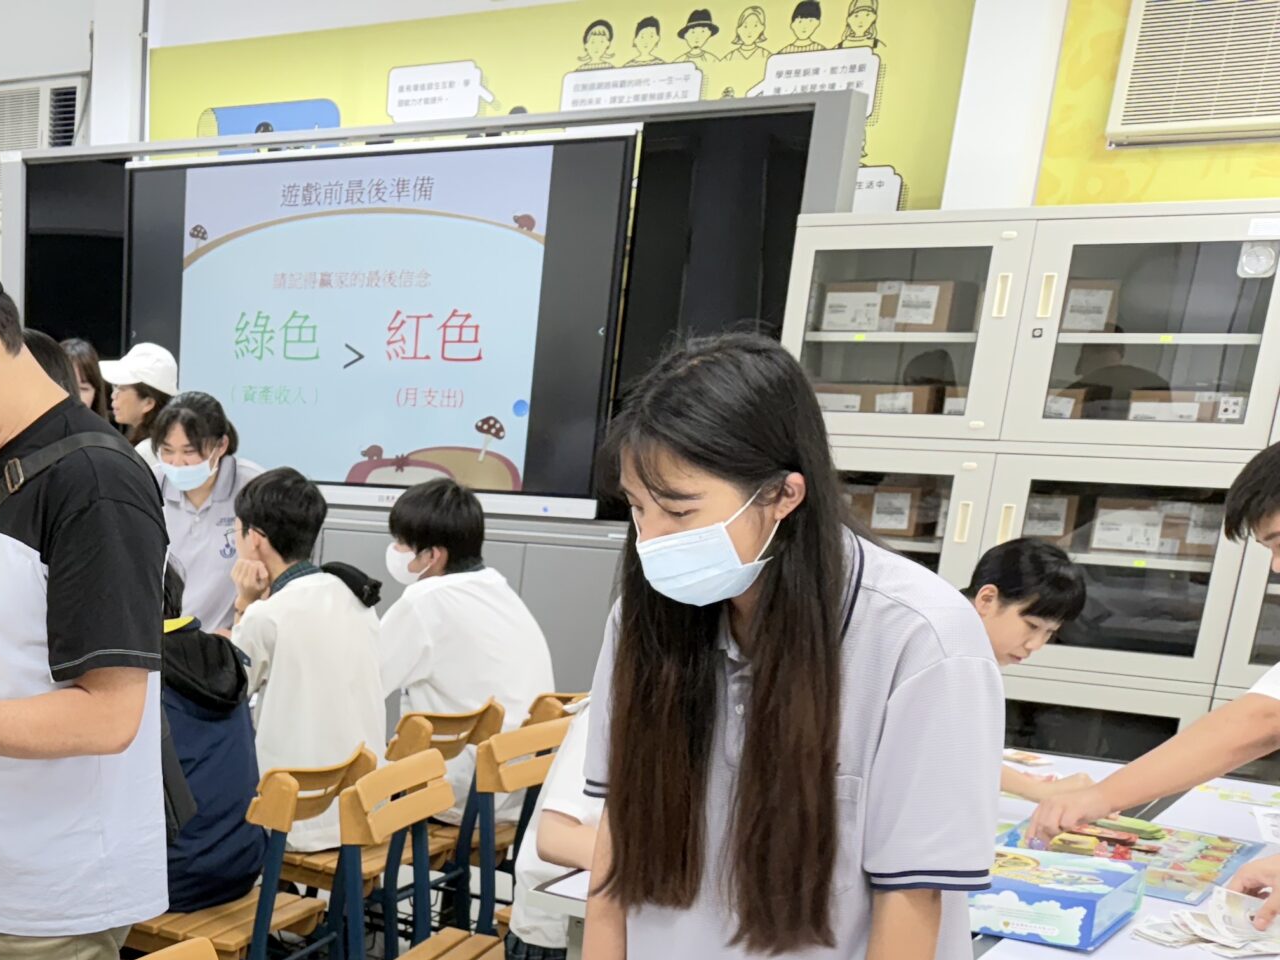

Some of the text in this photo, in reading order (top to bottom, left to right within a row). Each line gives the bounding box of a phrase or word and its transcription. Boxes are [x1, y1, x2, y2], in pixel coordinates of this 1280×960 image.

[280, 176, 434, 208] 遊戲前最後準備
[273, 268, 432, 290] 請記得贏家的最後信念
[234, 309, 320, 361] 綠色
[385, 308, 483, 362] 紅色
